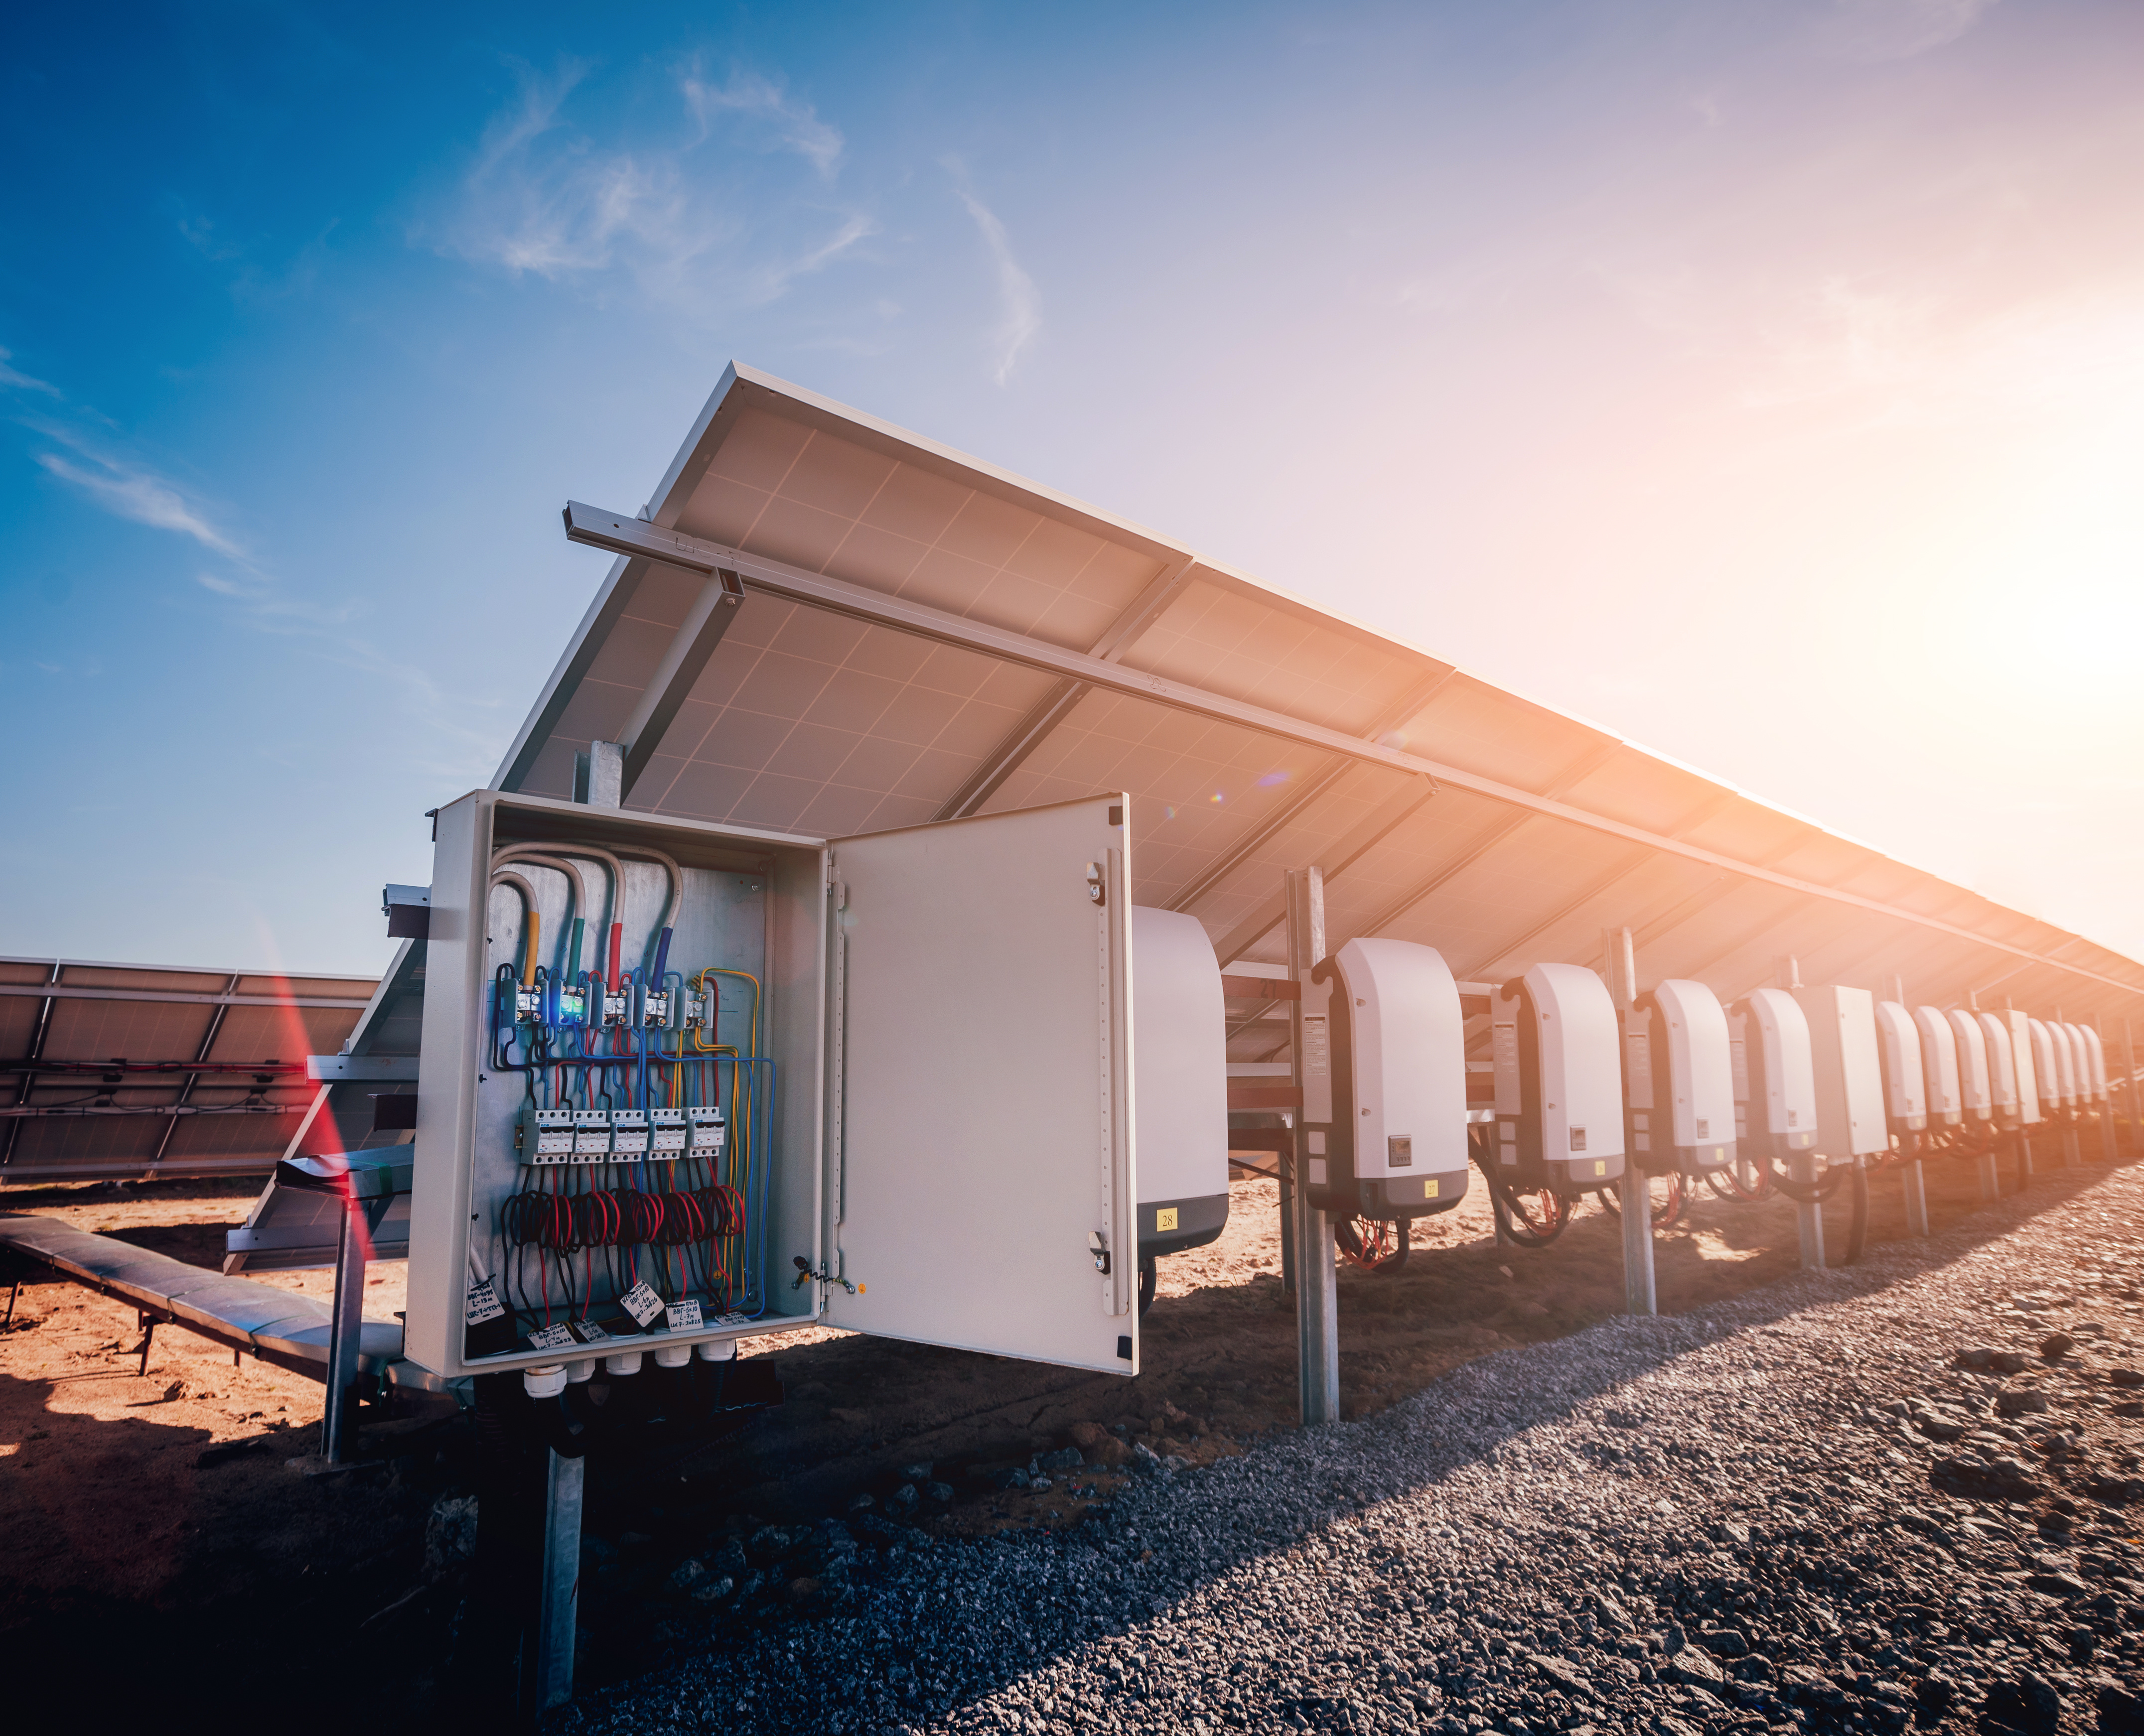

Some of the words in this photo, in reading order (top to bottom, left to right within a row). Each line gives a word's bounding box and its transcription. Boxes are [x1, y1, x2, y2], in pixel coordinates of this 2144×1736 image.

[1260, 979, 1277, 999] 27
[1428, 1185, 1435, 1195] 27
[1162, 1214, 1173, 1227] 28
